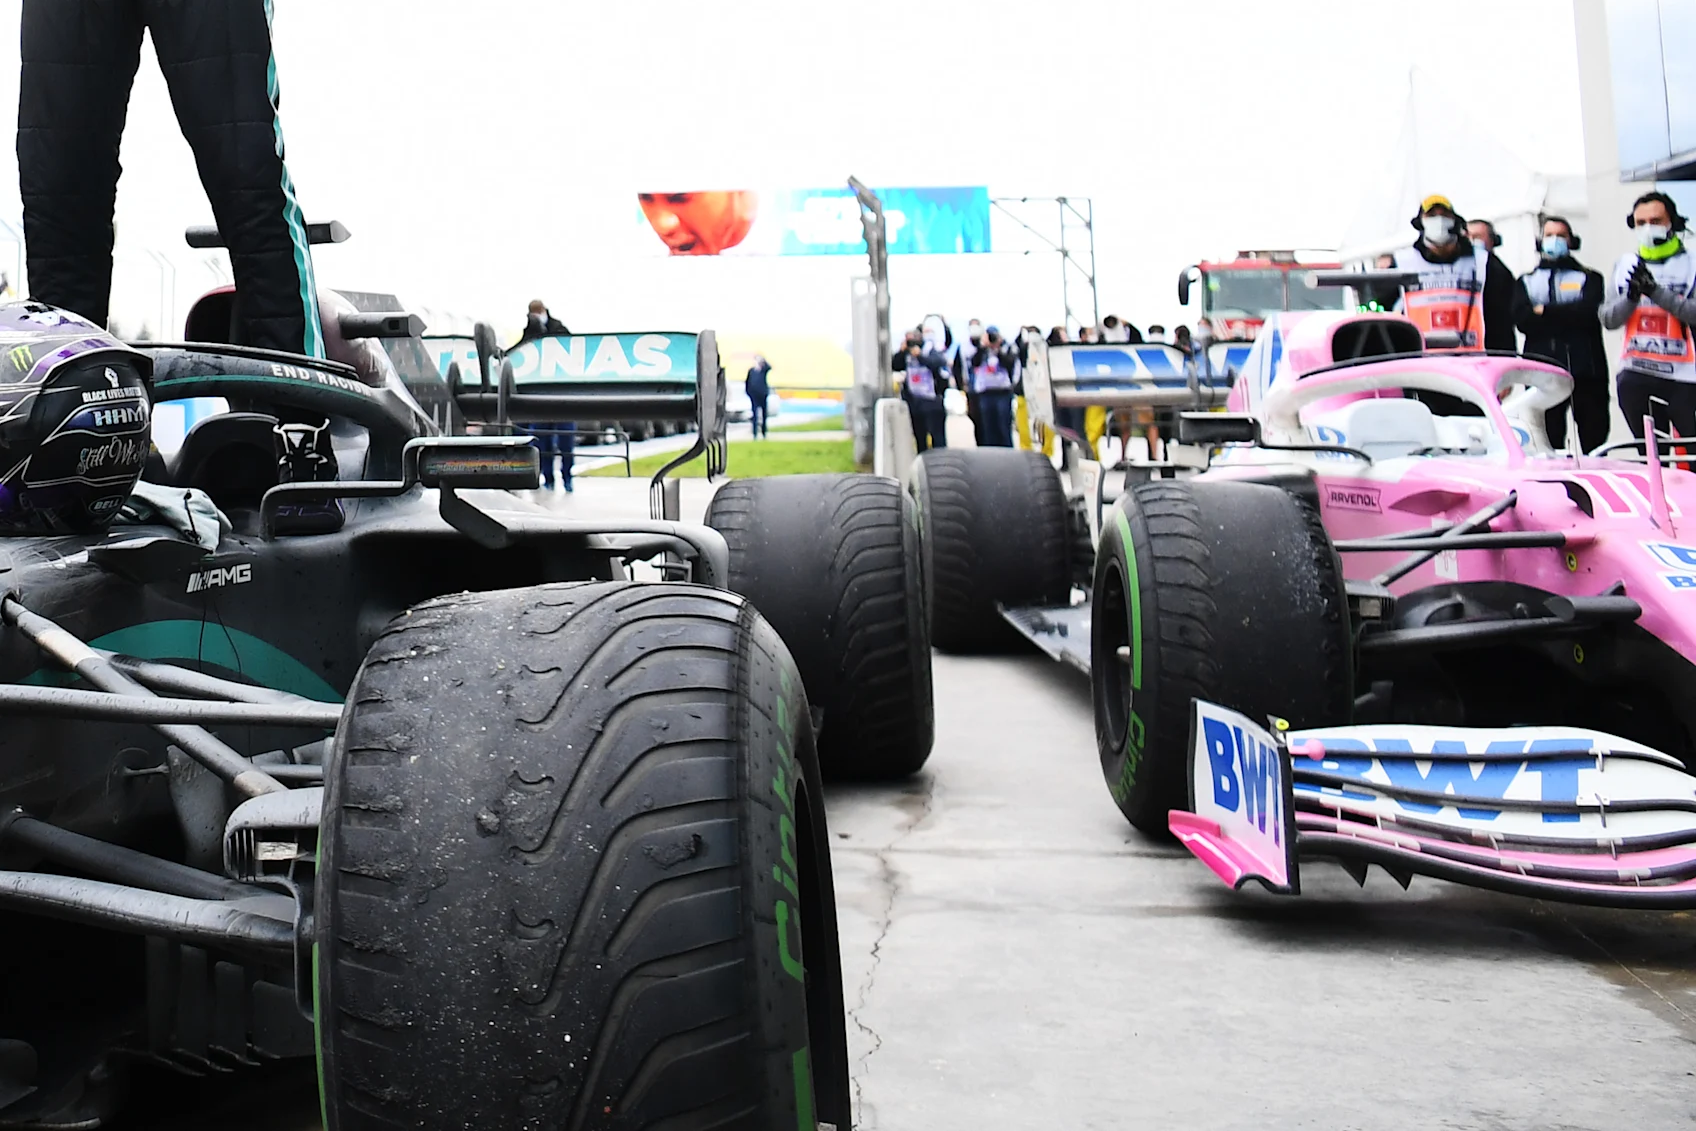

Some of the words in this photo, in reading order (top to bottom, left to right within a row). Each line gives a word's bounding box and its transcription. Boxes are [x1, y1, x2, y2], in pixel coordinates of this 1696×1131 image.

[271, 363, 311, 381] END
[82, 389, 108, 404] BLACK
[93, 497, 120, 510] BELL
[1330, 489, 1377, 508] RAVENOL
[206, 563, 252, 589] AMG
[1202, 715, 1281, 849] BWT
[1292, 738, 1597, 823] BWT
